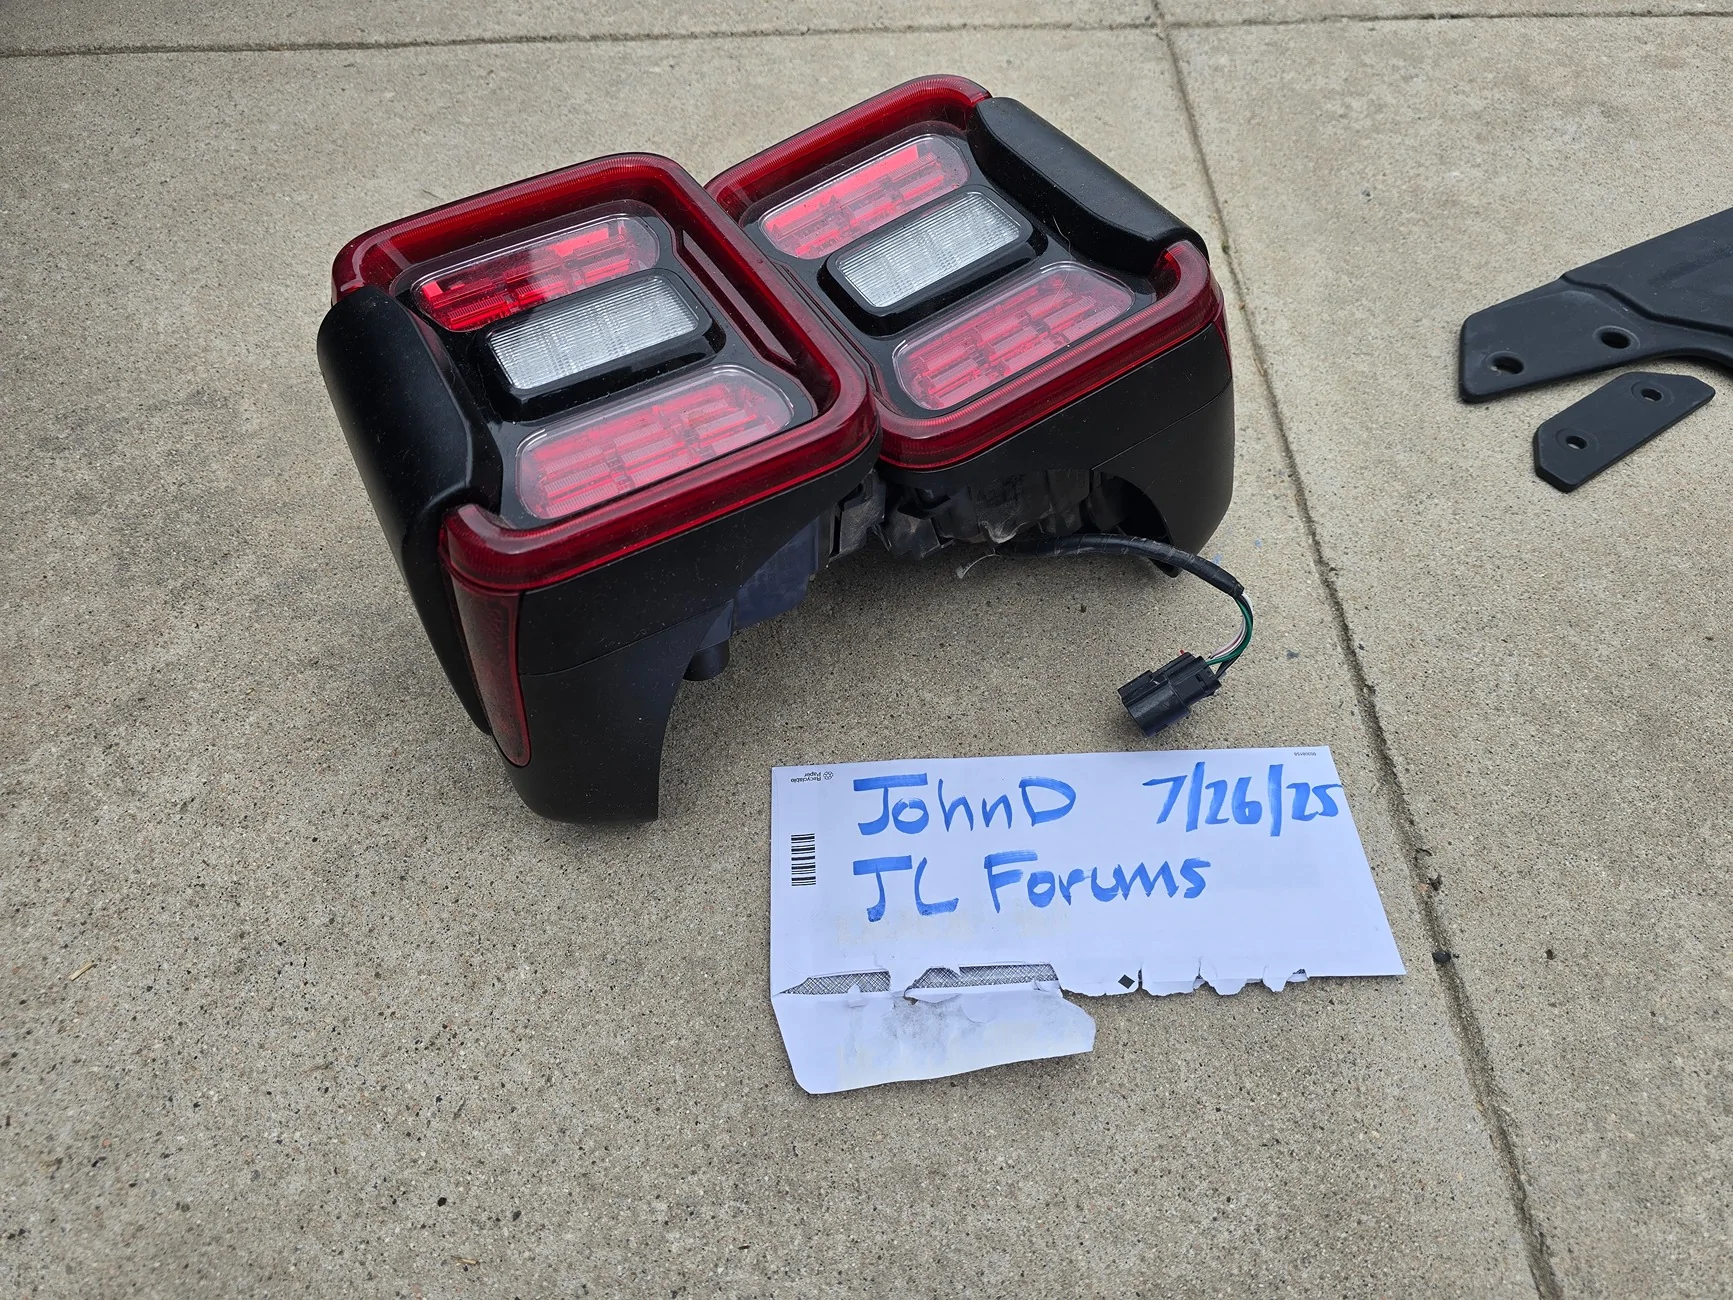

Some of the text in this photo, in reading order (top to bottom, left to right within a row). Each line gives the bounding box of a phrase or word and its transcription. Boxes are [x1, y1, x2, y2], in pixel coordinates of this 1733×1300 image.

[1142, 761, 1342, 837] 7/26/25
[852, 849, 1212, 922] JL Forums
